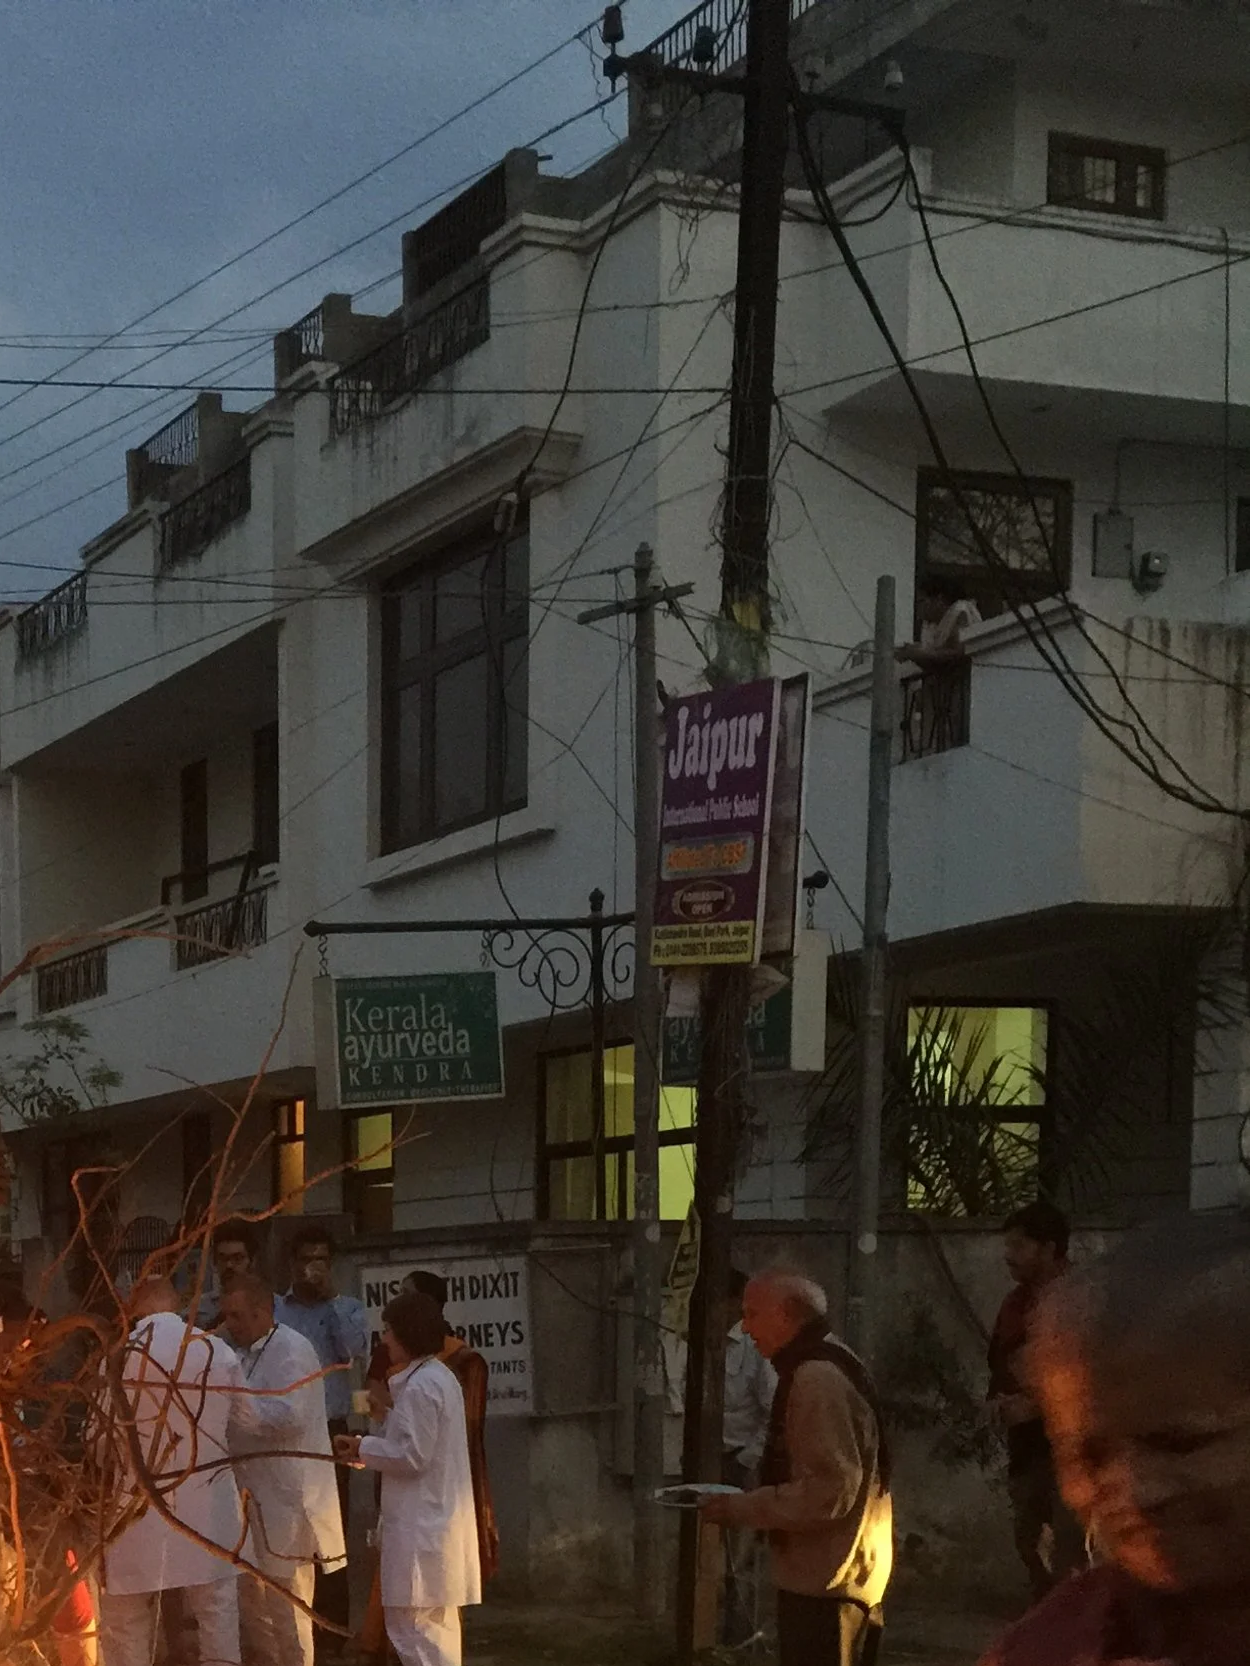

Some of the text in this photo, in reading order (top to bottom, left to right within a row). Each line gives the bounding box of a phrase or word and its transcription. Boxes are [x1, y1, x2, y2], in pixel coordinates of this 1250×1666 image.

[668, 702, 764, 791] Jaipur
[690, 902, 713, 915] OPEN
[344, 993, 447, 1033] Kerala
[344, 1022, 470, 1069] ayurveda
[349, 1060, 474, 1086] KENDRA
[469, 1271, 519, 1300] DIXIT
